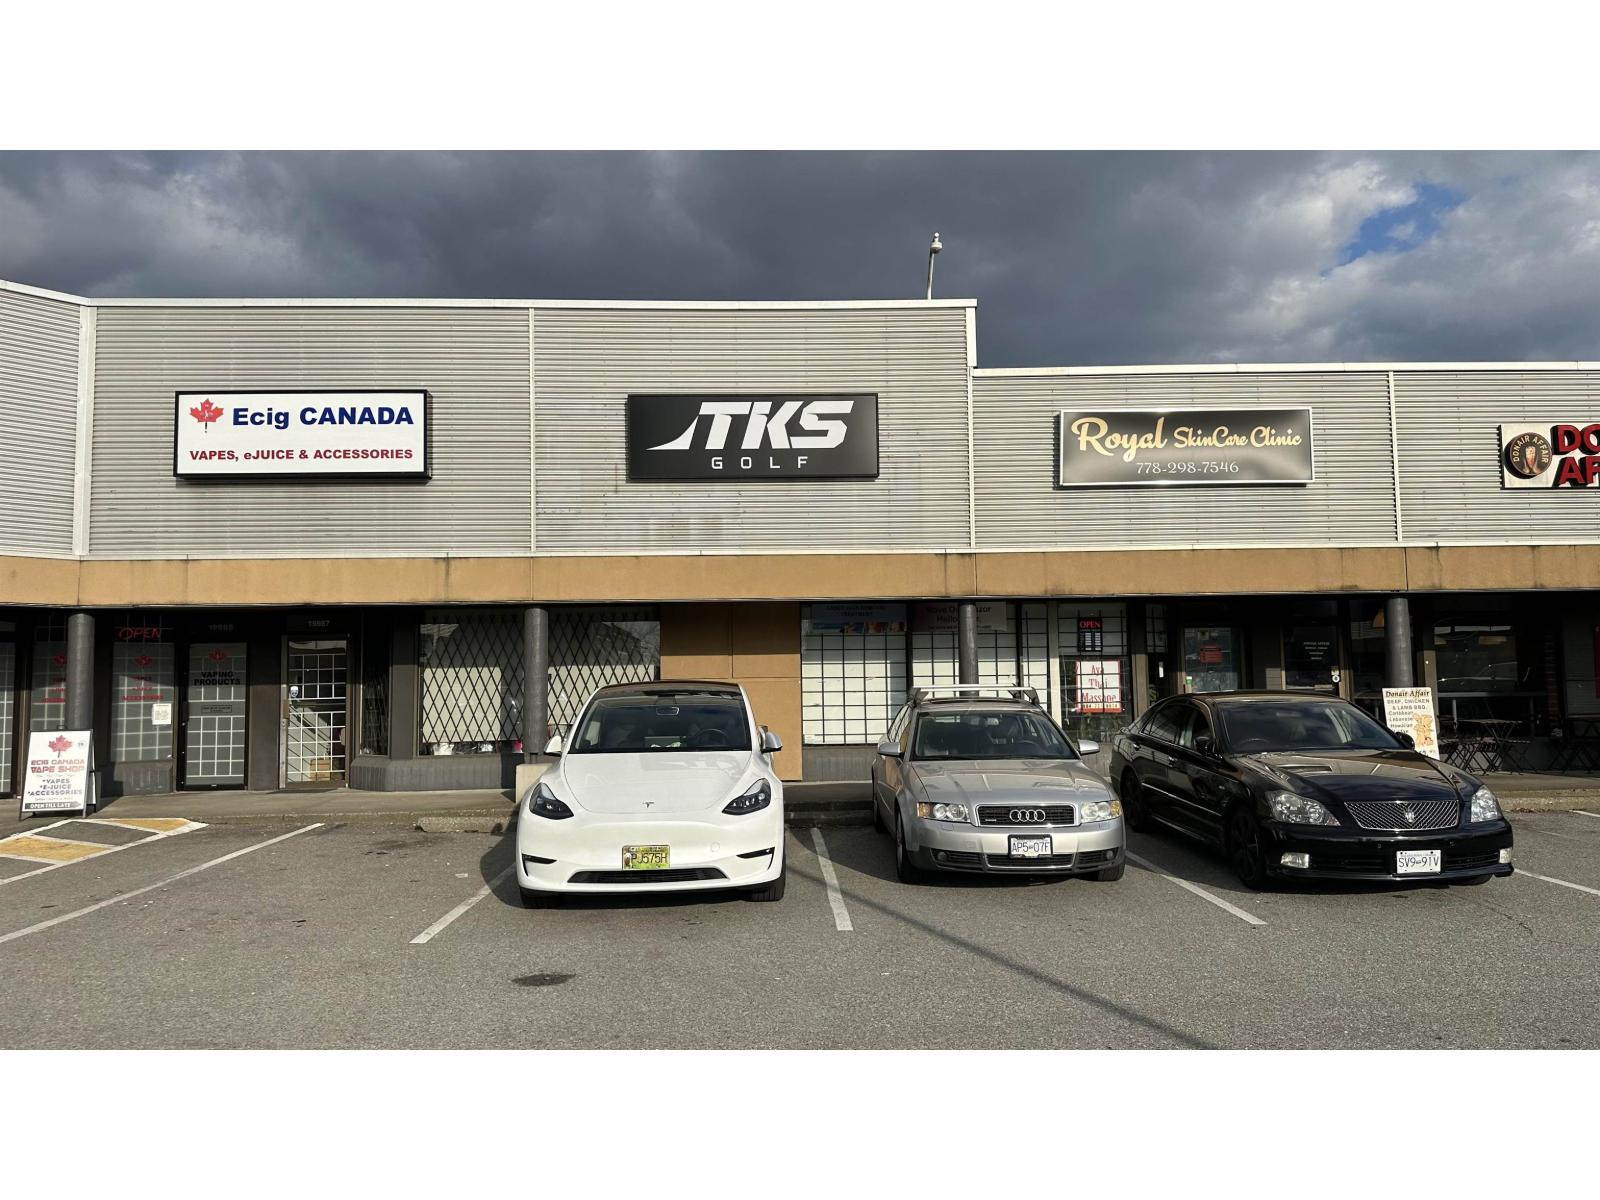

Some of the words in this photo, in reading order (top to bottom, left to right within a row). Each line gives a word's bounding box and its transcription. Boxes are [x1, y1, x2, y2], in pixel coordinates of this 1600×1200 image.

[233, 407, 290, 430] Ecig
[300, 406, 414, 425] CANADA
[698, 400, 855, 450] TKS
[1071, 416, 1168, 462] Royal
[1173, 426, 1248, 448] SkinCare
[1250, 426, 1302, 448] Clinic
[1512, 434, 1530, 462] DONAIR
[1532, 436, 1549, 463] AFFAIR
[189, 450, 239, 462] VAPES,
[243, 450, 295, 460] eJUICE
[298, 450, 309, 460] &
[313, 449, 413, 460] ACCESSORIES
[711, 456, 808, 469] GOLF
[1136, 461, 1239, 474] 778-298-7546
[1080, 621, 1101, 629] OPEN
[118, 627, 161, 640] OPEN
[1410, 690, 1430, 698] Affair
